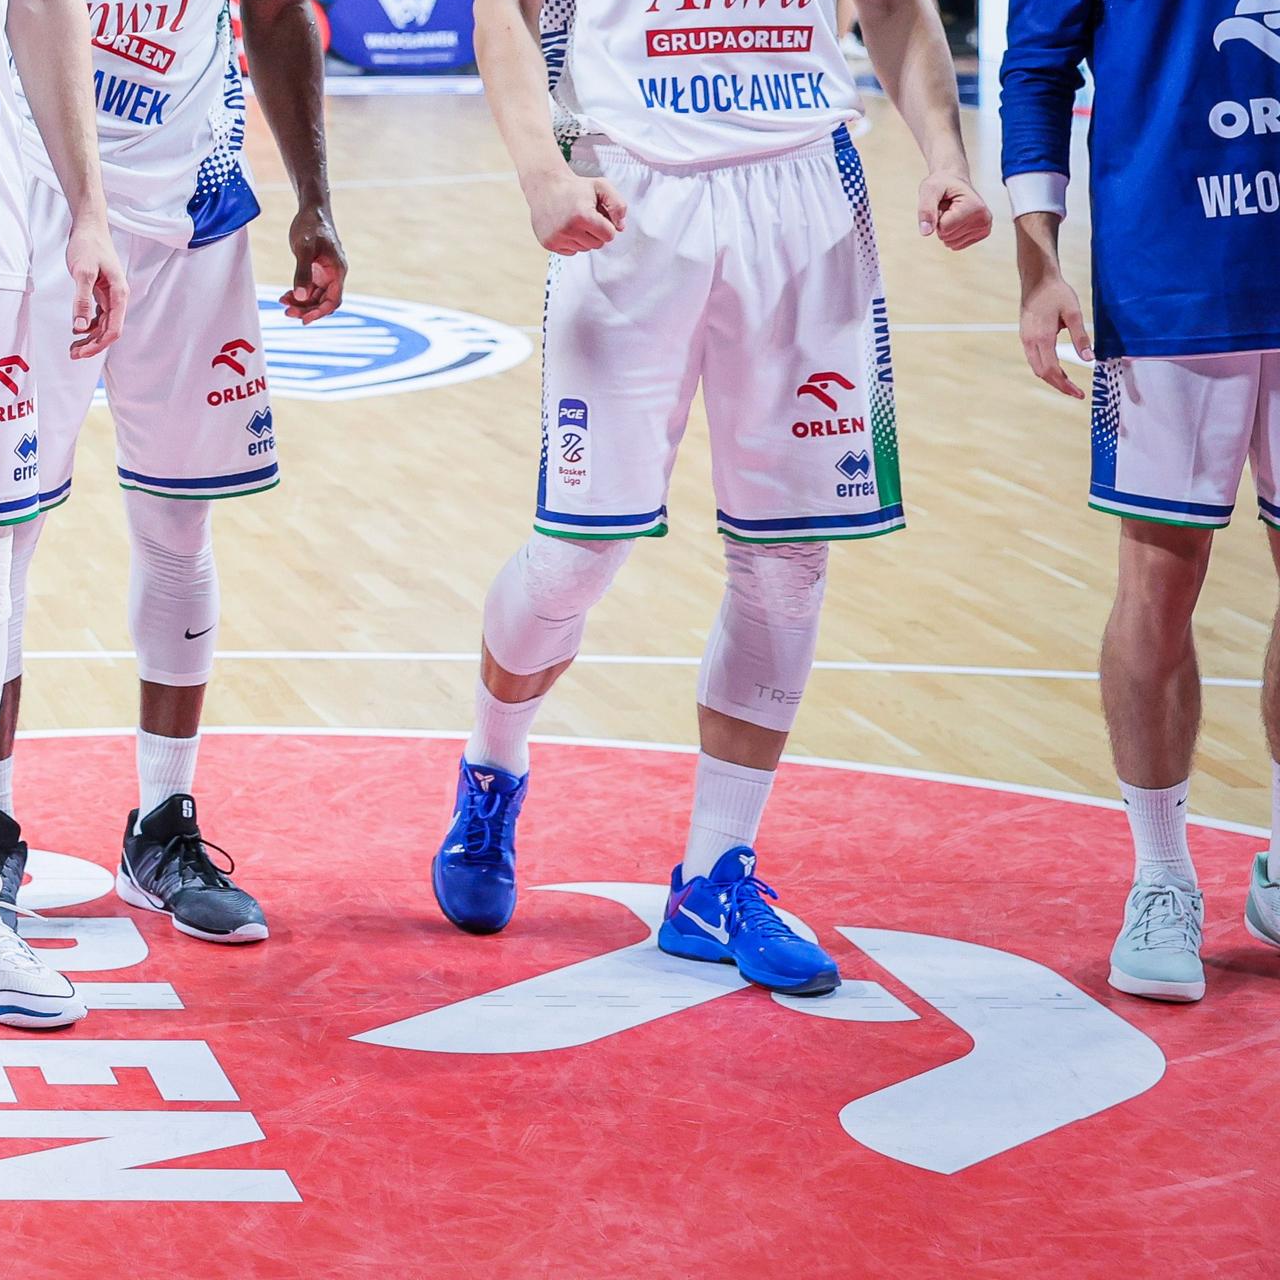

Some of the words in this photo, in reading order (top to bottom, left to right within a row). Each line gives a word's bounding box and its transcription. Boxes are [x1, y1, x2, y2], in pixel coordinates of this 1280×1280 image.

[638, 72, 830, 114] WŁOCŁAWEK
[207, 376, 267, 407] ORLEN
[559, 407, 586, 420] PGE
[792, 416, 865, 440] ORLEN
[558, 467, 587, 479] Basket
[563, 476, 582, 487] Liga
[836, 480, 875, 498] errea
